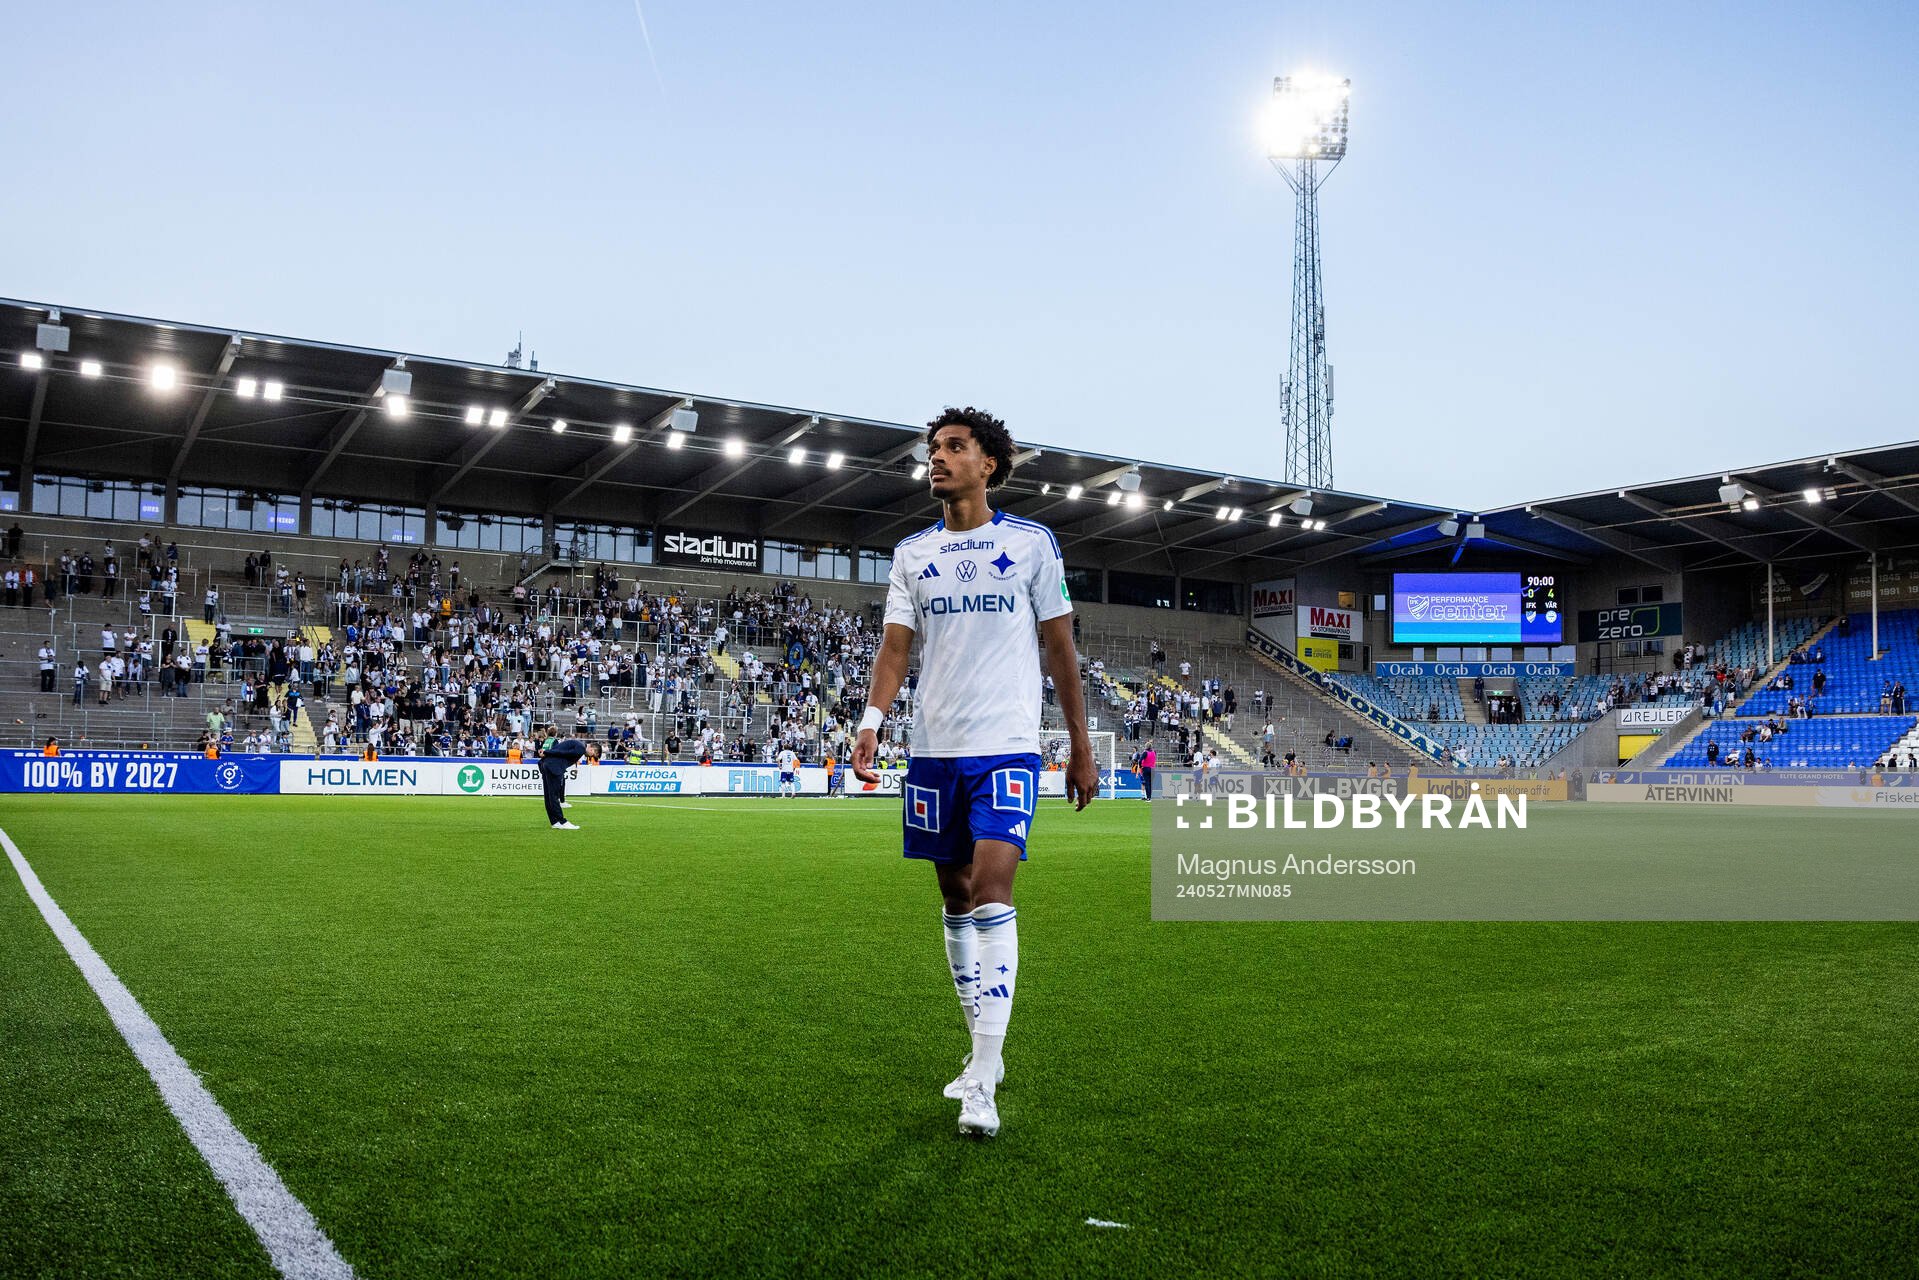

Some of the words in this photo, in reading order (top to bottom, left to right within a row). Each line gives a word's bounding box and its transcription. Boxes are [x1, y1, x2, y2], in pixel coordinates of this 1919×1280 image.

[664, 532, 757, 560] stadium
[940, 539, 994, 554] stadium
[1528, 576, 1554, 586] 90:00
[1254, 589, 1293, 607] MAXI
[1431, 596, 1488, 604] PERFORMANCE
[1528, 588, 1534, 598] 0
[1548, 588, 1554, 598] 4
[920, 595, 1015, 618] HOLMEN
[1430, 603, 1507, 620] center
[1310, 607, 1351, 628] MAXI
[1598, 609, 1630, 626] pre
[1598, 625, 1642, 639] zero
[1247, 631, 1328, 690] CURVA
[1390, 663, 1423, 676] Ocab
[1435, 663, 1468, 676] Ocab
[1482, 663, 1515, 676] Ocab
[1526, 663, 1560, 676] Ocab
[24, 762, 82, 787] 100%
[91, 762, 118, 787] BY
[125, 762, 178, 788] 2027
[308, 768, 417, 786] HOLMEN
[492, 769, 578, 781] LUNDBGS
[616, 769, 677, 779] STATHÖGA
[1669, 774, 1744, 785] HOLMEN
[615, 783, 660, 791] VERKSTAD
[664, 783, 676, 791] AB
[1185, 778, 1245, 793] TKNOS
[1297, 777, 1397, 798] XL-BYGG
[1486, 784, 1496, 795] En
[1498, 785, 1528, 796] enklare
[1645, 784, 1733, 802] ÅTERVINN!
